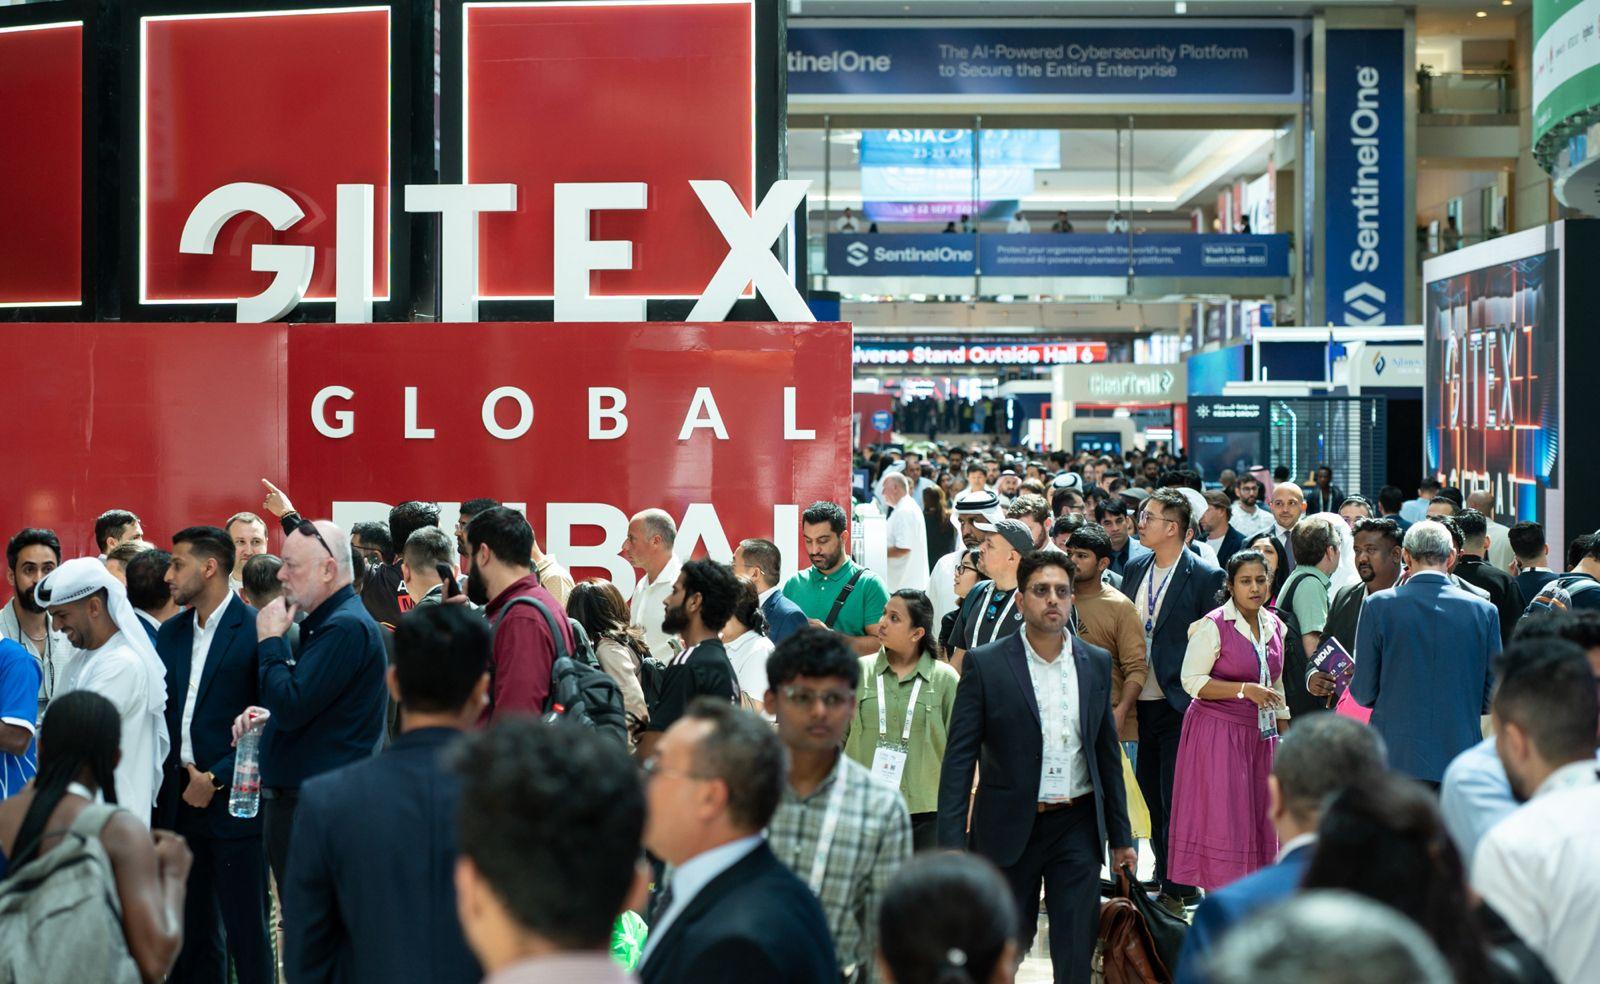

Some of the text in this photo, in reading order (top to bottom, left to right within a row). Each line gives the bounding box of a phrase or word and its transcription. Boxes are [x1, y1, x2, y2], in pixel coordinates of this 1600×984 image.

[787, 50, 891, 71] tinelOne
[938, 44, 1248, 62] The AI-Powered Cybersecurity Platform
[938, 62, 1177, 80] to Secure the Entire Enterprise
[1351, 66, 1379, 272] SentinelOne
[180, 180, 816, 323] GITEX
[874, 247, 973, 262] SentinelOne
[853, 345, 1094, 364] iverse Stand Outside Hall 6
[311, 386, 816, 440] GLOBAL
[1313, 644, 1335, 667] INDIA
